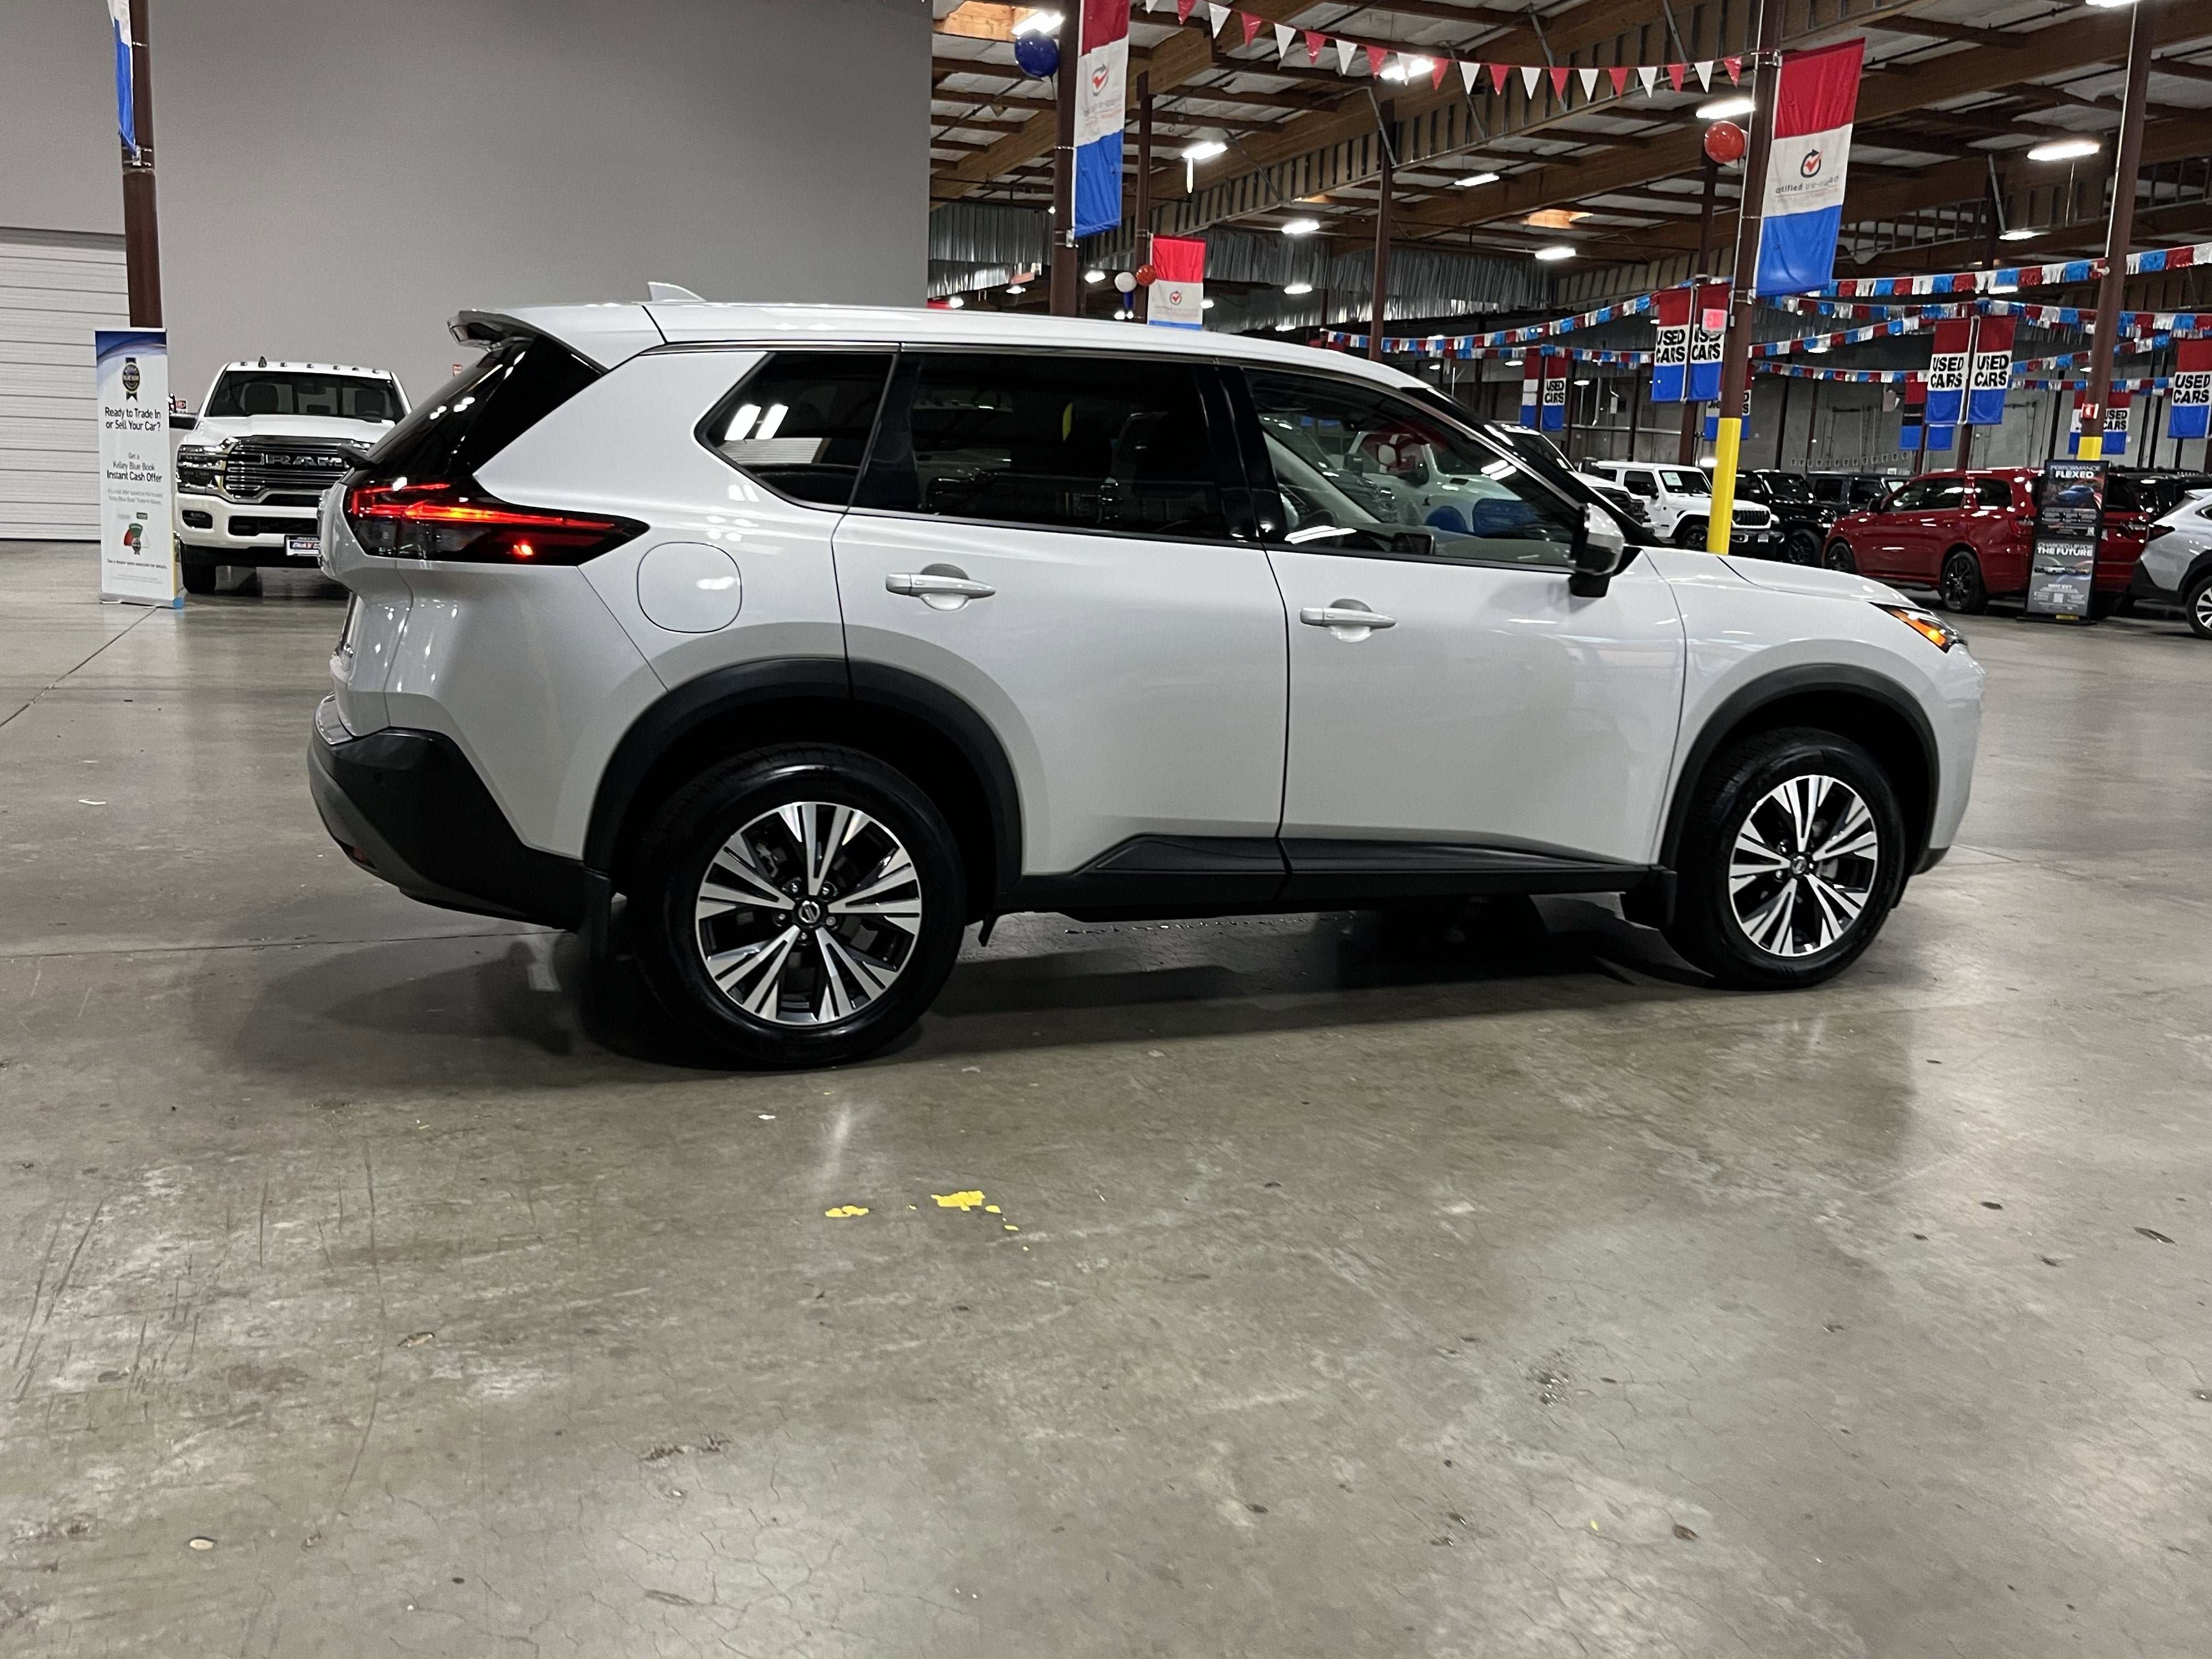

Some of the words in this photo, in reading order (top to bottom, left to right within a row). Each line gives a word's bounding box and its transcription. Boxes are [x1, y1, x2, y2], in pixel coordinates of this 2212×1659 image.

[1657, 329, 1685, 346] USED
[1656, 346, 1685, 363] CARS
[1692, 343, 1720, 360] CARS
[1933, 357, 1964, 372] USED
[1977, 354, 2009, 371] USED
[1547, 380, 1565, 391] USED
[1931, 373, 1962, 388] CARS
[1975, 370, 2007, 387] CARS
[2175, 375, 2210, 389] USED
[2174, 389, 2209, 404] CARS
[105, 407, 125, 420] Ready
[126, 408, 133, 417] to
[134, 408, 153, 419] Trade
[154, 409, 161, 419] In
[115, 419, 127, 430] Sell
[128, 420, 143, 430] Your
[145, 421, 161, 432] Car?
[113, 461, 128, 472] Kelley
[129, 461, 141, 470] Blue
[142, 462, 155, 471] Book
[266, 454, 349, 467] RAM
[106, 470, 128, 480] Instant
[129, 471, 145, 481] Cash
[146, 472, 162, 483] Offer
[2055, 470, 2094, 479] FLEXED
[2056, 548, 2093, 557] FUTURE
